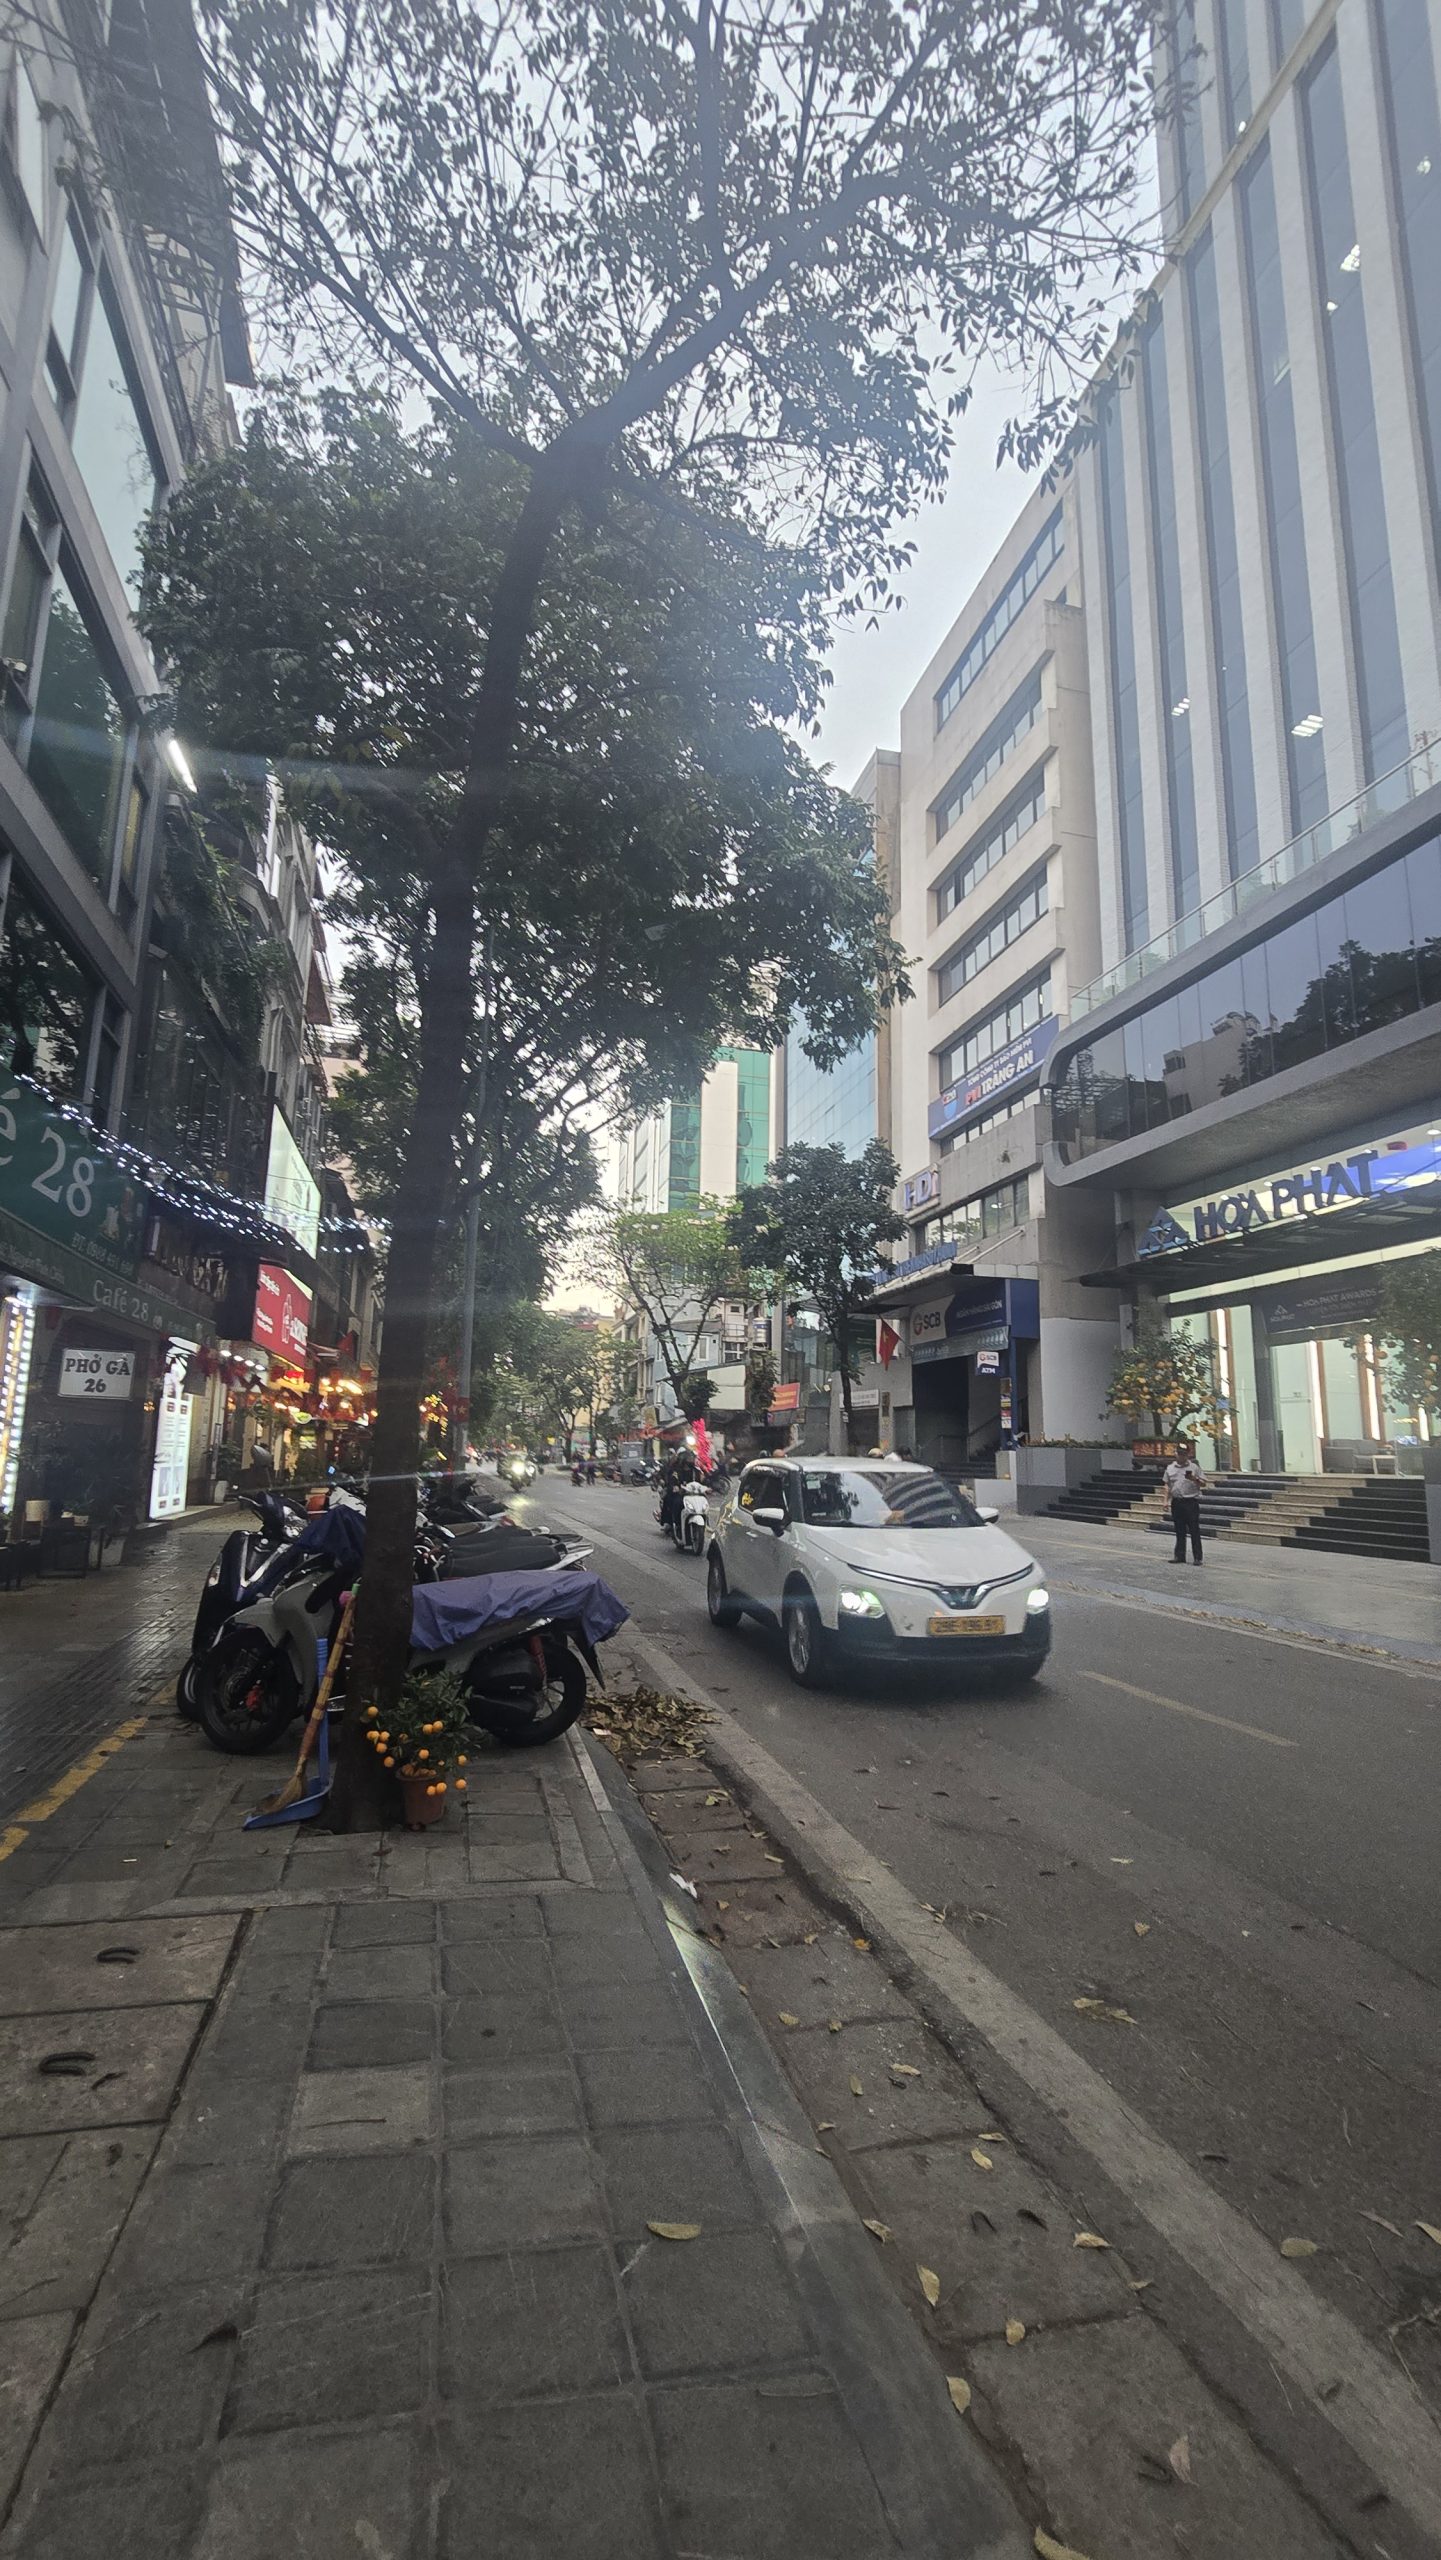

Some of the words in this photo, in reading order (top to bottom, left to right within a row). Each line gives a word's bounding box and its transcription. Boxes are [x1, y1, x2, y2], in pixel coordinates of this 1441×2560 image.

[1016, 1049, 1034, 1073] AN
[32, 1126, 95, 1217] 28
[93, 1279, 128, 1313] Café
[131, 1297, 149, 1321] 28
[923, 1311, 941, 1330] SCB
[64, 1353, 102, 1374] PHỞ
[105, 1356, 131, 1376] GÀ
[84, 1378, 107, 1393] 26
